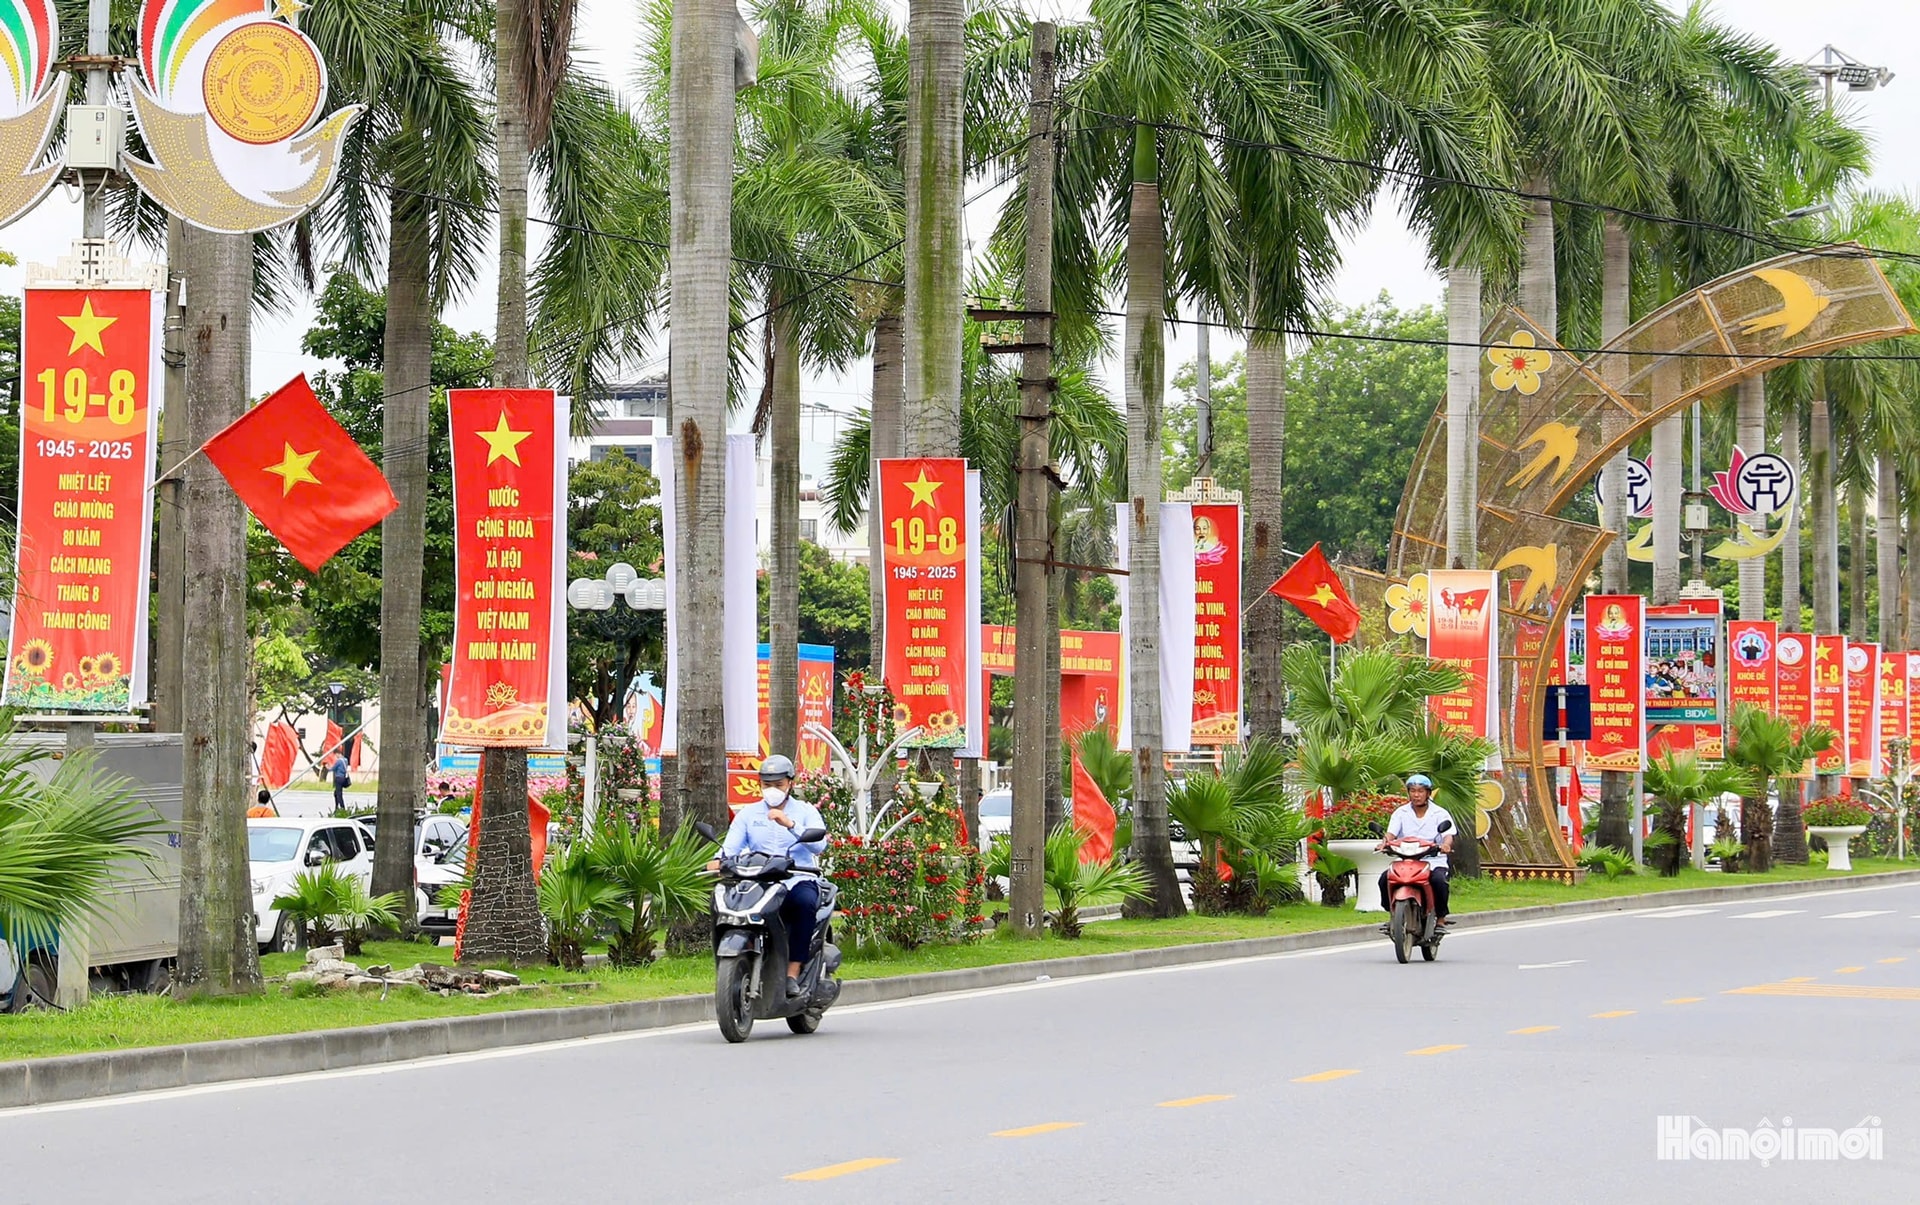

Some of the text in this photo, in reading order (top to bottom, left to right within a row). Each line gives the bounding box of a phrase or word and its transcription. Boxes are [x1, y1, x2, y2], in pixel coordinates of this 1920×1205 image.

[37, 367, 136, 425] 19-8
[36, 440, 75, 457] 1945
[88, 440, 133, 459] 2025
[58, 470, 111, 495] NHIỆT LIỆT
[488, 485, 519, 507] NƯỚC
[53, 499, 114, 519] CHÀO MỪNG
[62, 526, 101, 547] 80 NĂM
[476, 516, 534, 542] CỘNG HOÀ
[891, 517, 957, 555] 19-8
[50, 553, 111, 578] CÁCH MẠNG
[486, 546, 522, 572] XÃ HỘI
[893, 566, 917, 579] 1945
[927, 566, 957, 579] 2025
[57, 582, 99, 602] THÁNG 8
[474, 575, 535, 599] CHỦ NGHĨA
[908, 587, 943, 603] NHIỆT LIỆT
[906, 606, 946, 620] CHÀO MỪNG
[1205, 602, 1227, 617] VINH,
[42, 609, 111, 630] THÀNH CÔNG!
[477, 608, 529, 633] VIỆT NAM
[920, 625, 939, 639] NĂM
[1205, 621, 1220, 640] TỘC
[468, 638, 537, 660] MUÔN NĂM!
[905, 644, 947, 660] CÁCH MẠNG
[1201, 642, 1224, 660] HÙNG,
[910, 663, 940, 677] THÁNG 8
[1205, 664, 1214, 680] VĨ
[1214, 667, 1231, 682] ĐẠI!
[1614, 660, 1629, 669] MINH
[1815, 664, 1839, 683] 1-8
[902, 681, 949, 696] THÀNH CÔNG!
[1734, 685, 1770, 697] XÂY DỰNG
[1881, 678, 1904, 697] 9-8
[1442, 696, 1473, 708] CÁCH MẠNG
[1615, 702, 1634, 714] NGHIỆP
[1653, 699, 1670, 707] THÀNH
[1671, 699, 1680, 708] LẬP
[1688, 699, 1702, 707] ĐÔNG
[1605, 715, 1623, 726] CHÚNG
[1685, 709, 1708, 718] BIDV
